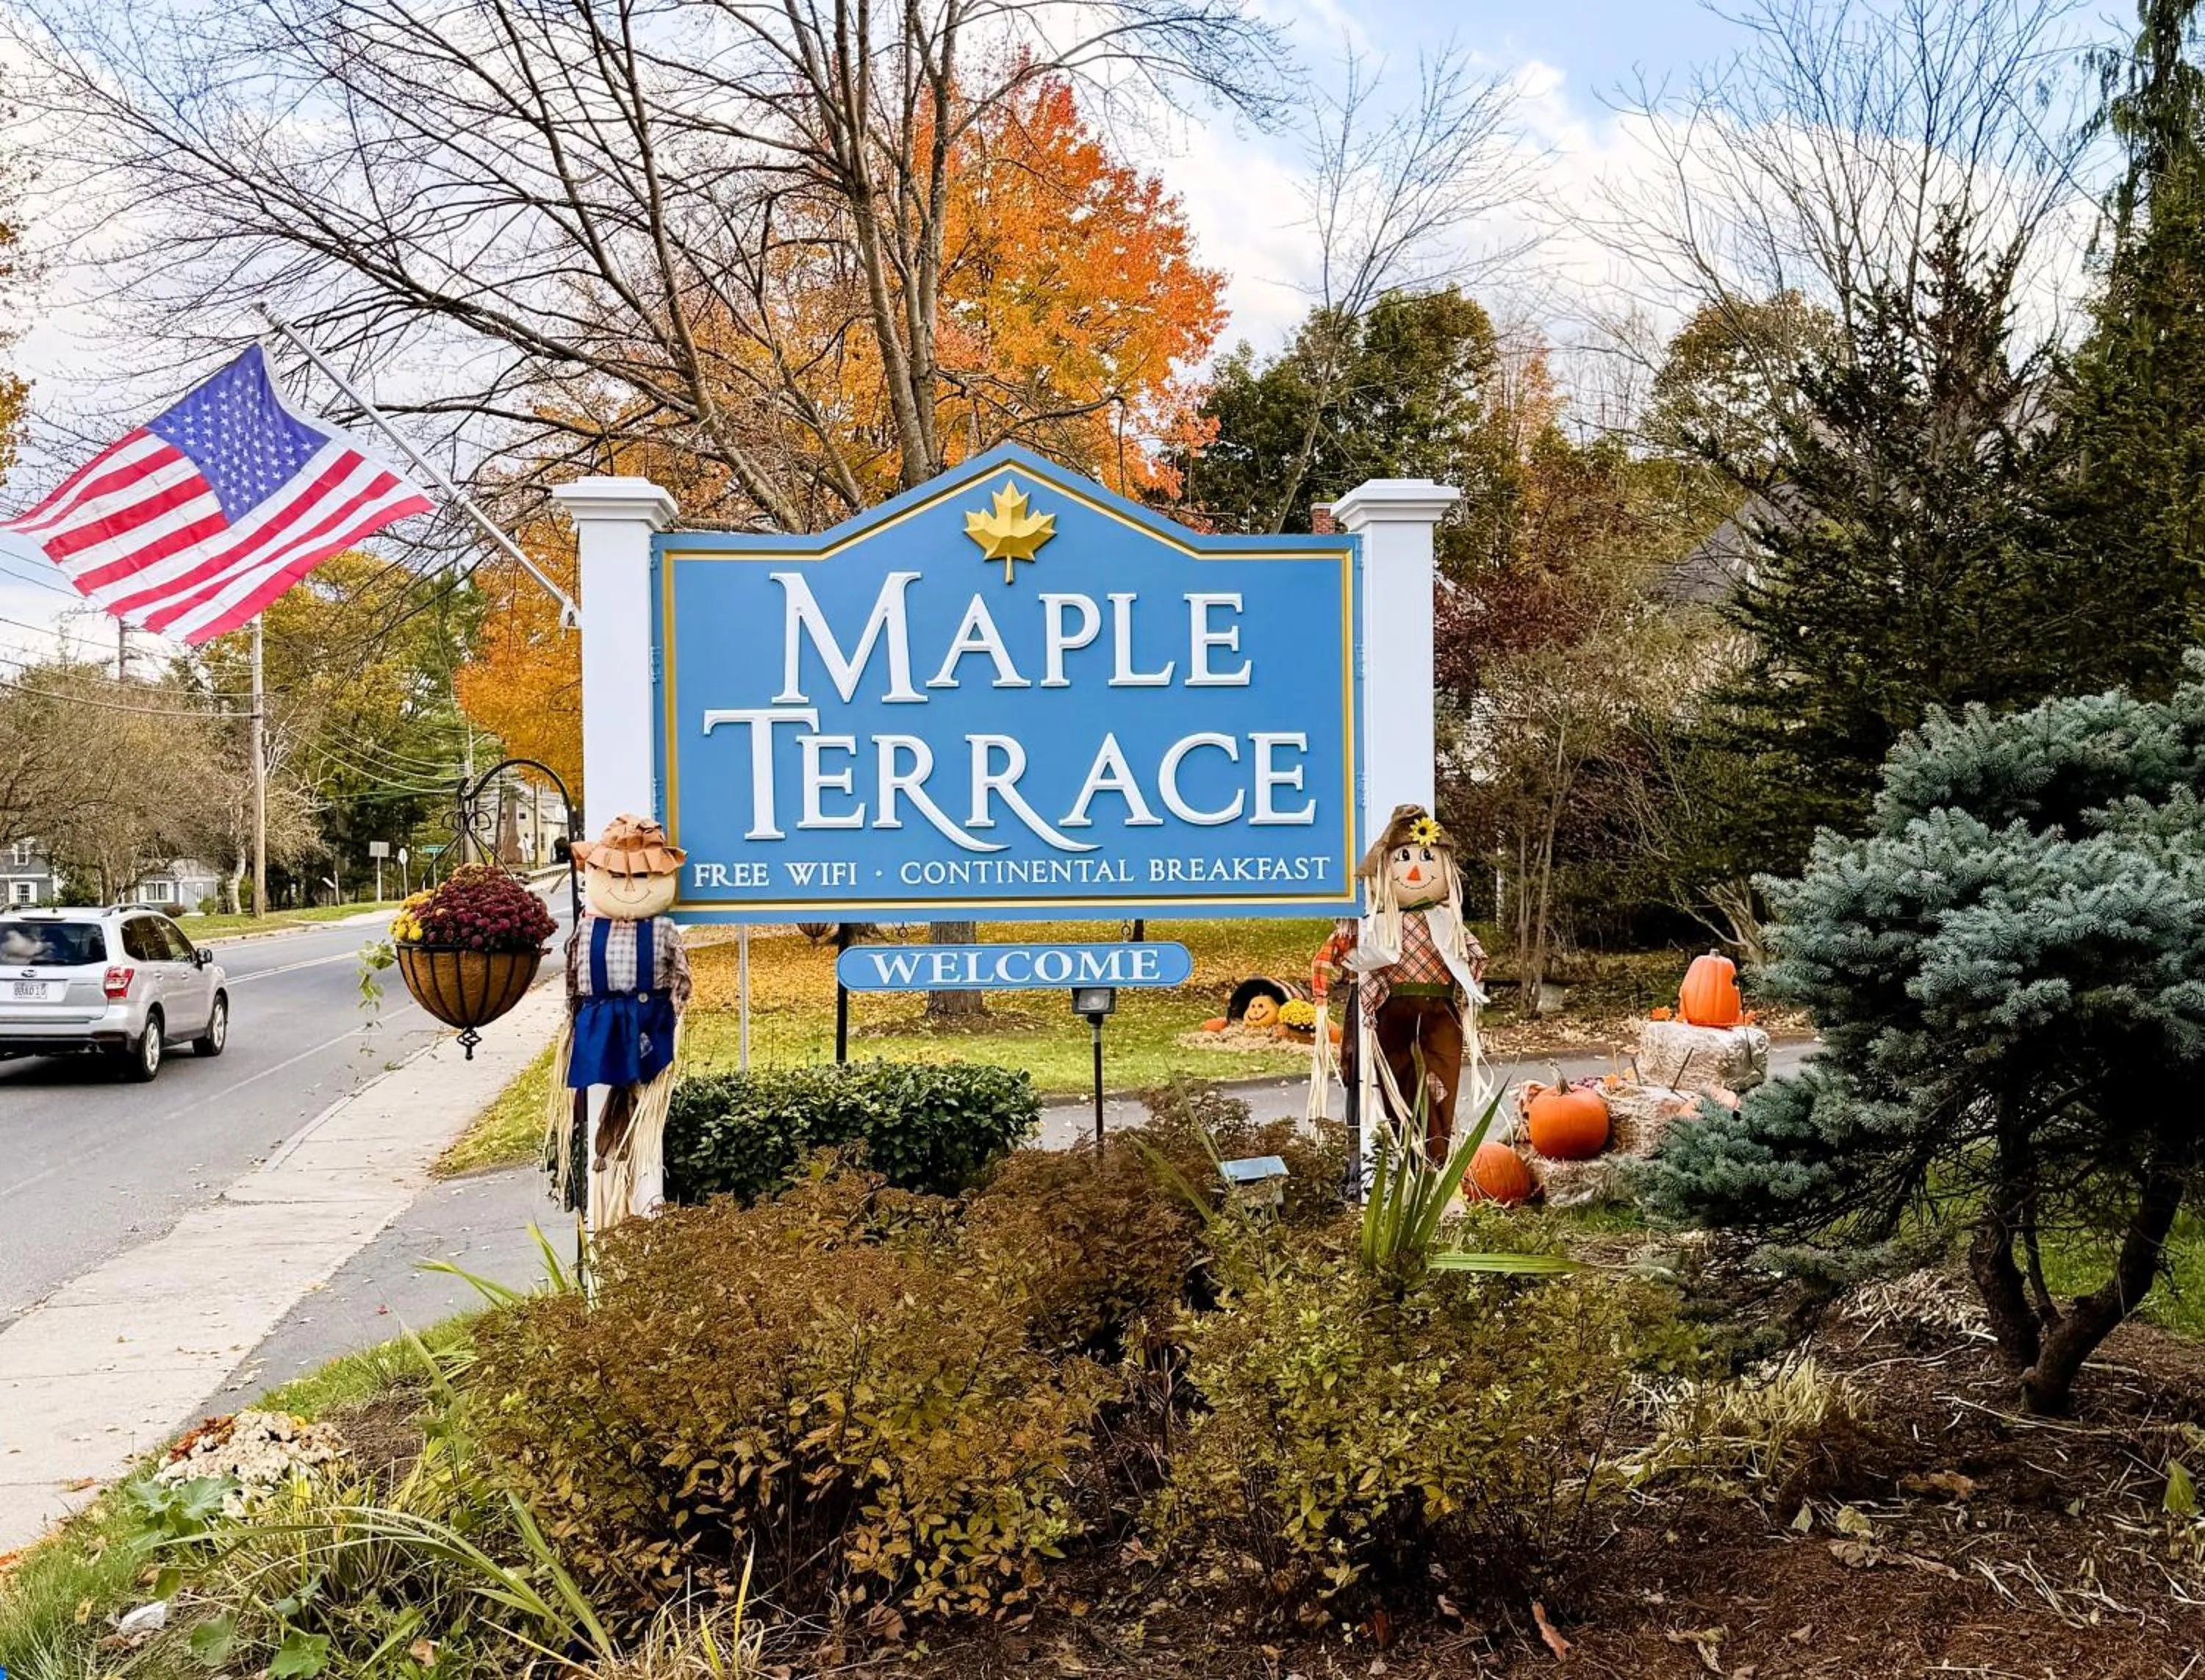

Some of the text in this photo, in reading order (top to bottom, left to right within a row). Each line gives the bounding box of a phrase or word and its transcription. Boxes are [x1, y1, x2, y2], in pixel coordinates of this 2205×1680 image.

[769, 571, 1252, 704] MAPLE
[703, 708, 1317, 852] TERRACE
[694, 857, 1331, 887] FREE WIFI CONTINENTAL BREAKFAST
[867, 949, 1161, 985] WELCOME
